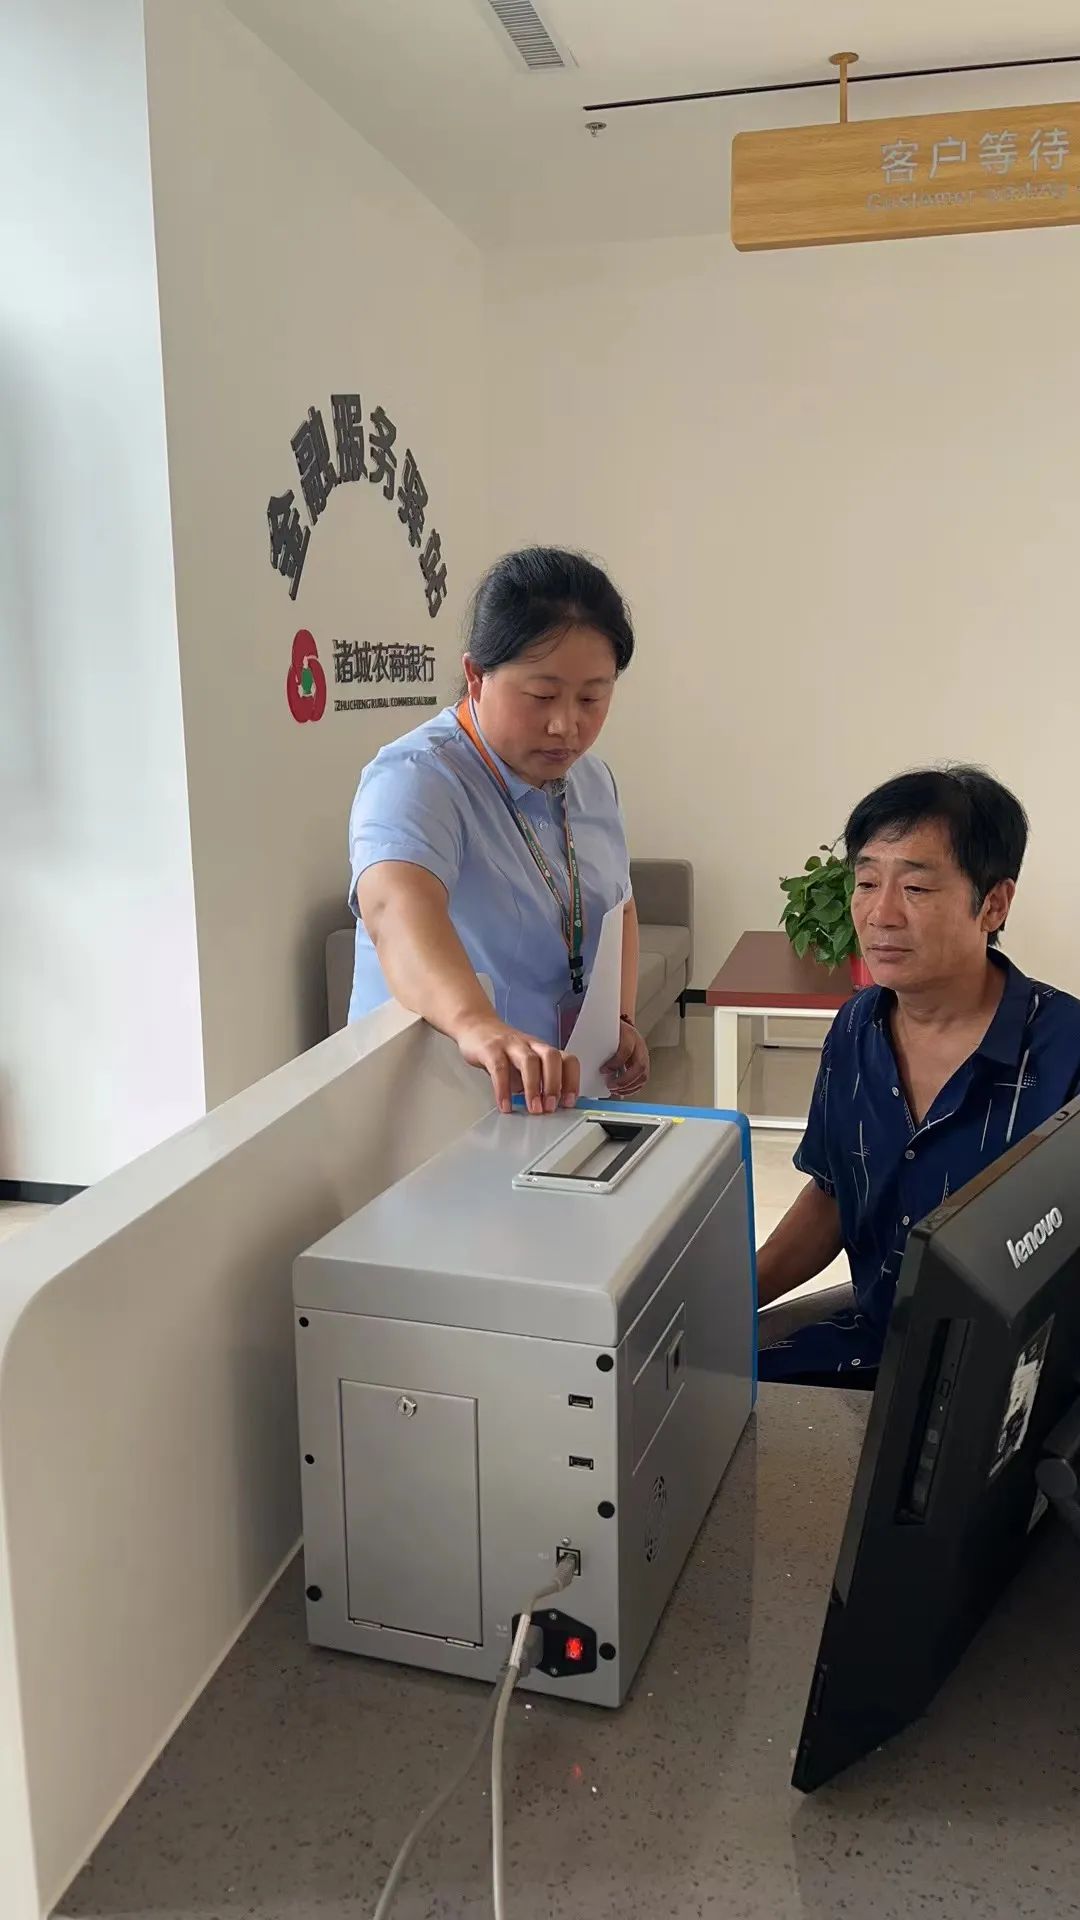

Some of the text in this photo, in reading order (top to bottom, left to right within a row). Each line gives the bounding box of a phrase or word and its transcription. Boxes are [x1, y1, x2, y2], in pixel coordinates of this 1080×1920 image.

[881, 128, 1070, 184] 客户等待
[267, 394, 447, 618] 金融服务驿站
[332, 639, 435, 683] 诸城农商银行
[1006, 1207, 1062, 1269] lenovo
